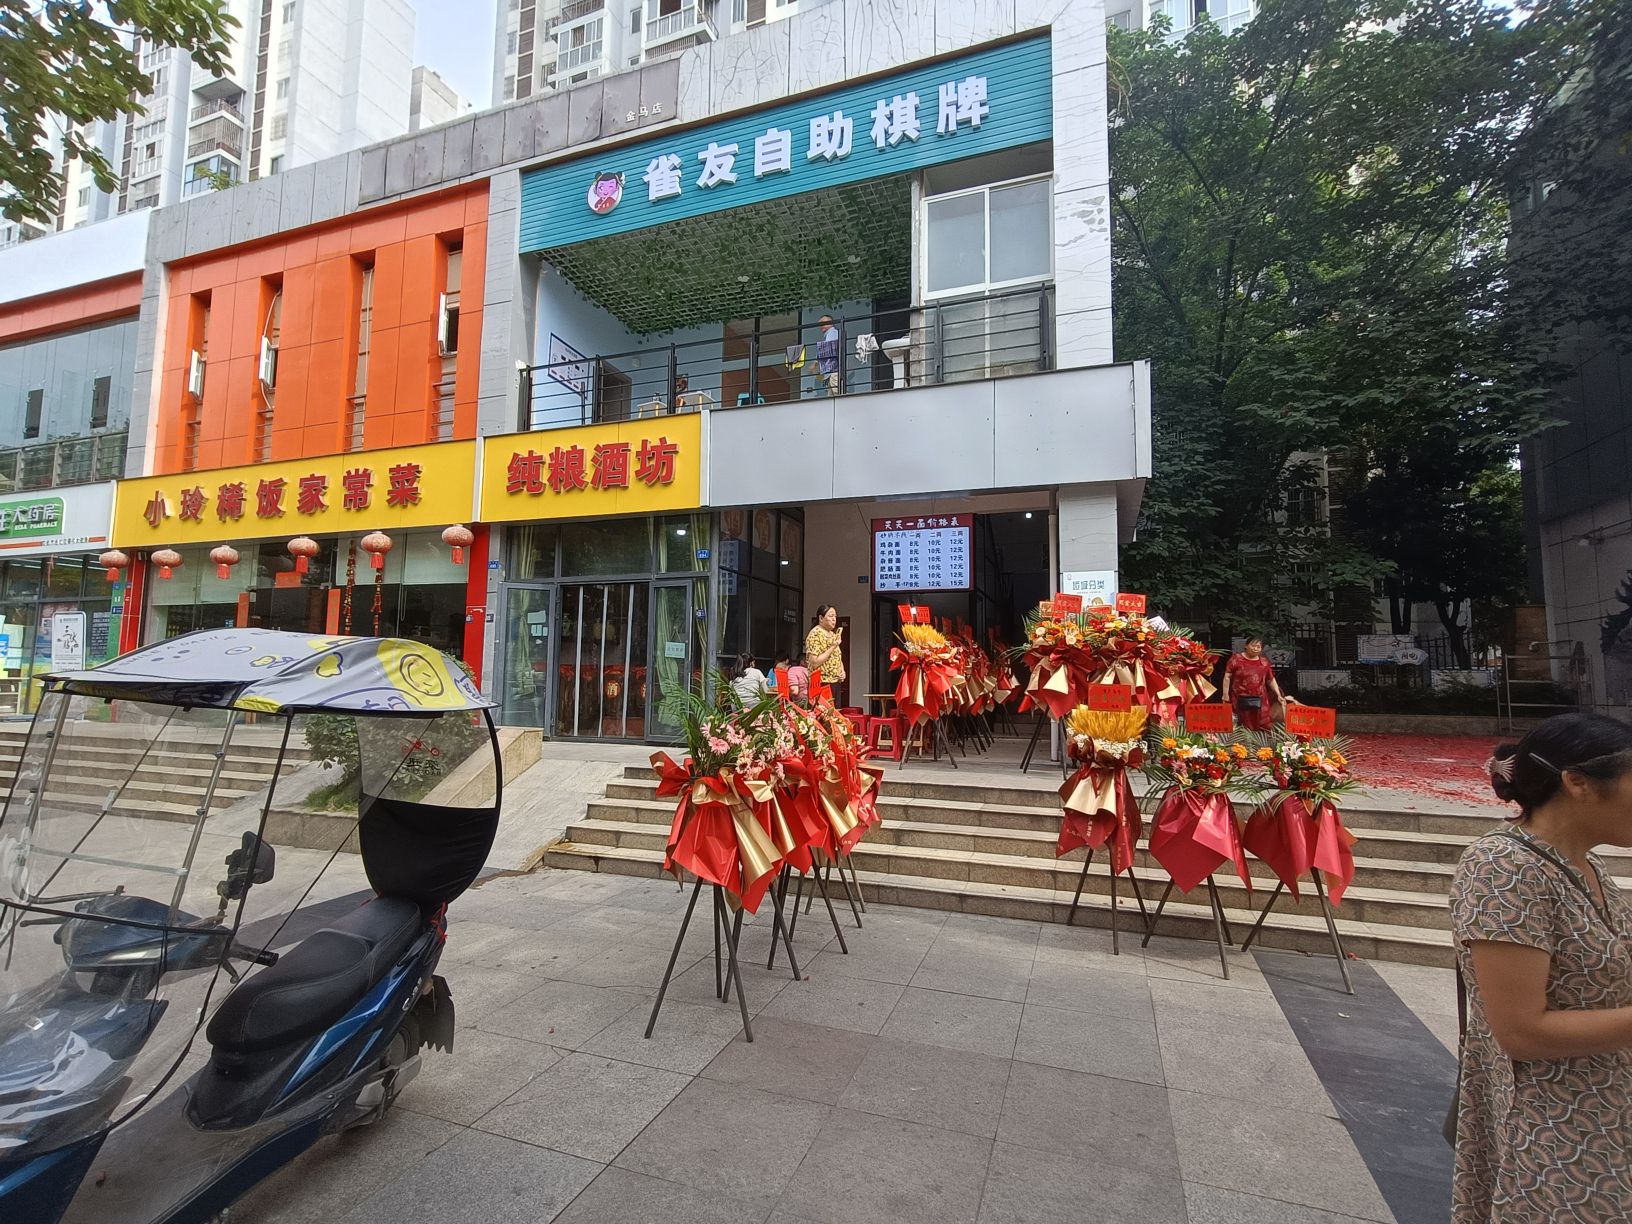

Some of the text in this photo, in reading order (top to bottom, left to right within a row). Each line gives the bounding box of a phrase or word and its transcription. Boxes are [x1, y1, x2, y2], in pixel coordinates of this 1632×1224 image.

[625, 102, 662, 122] 金马店
[642, 75, 989, 203] 雀友自助棋牌
[143, 463, 421, 528] 小玲稀饭家常菜
[507, 437, 680, 494] 纯粮酒坊
